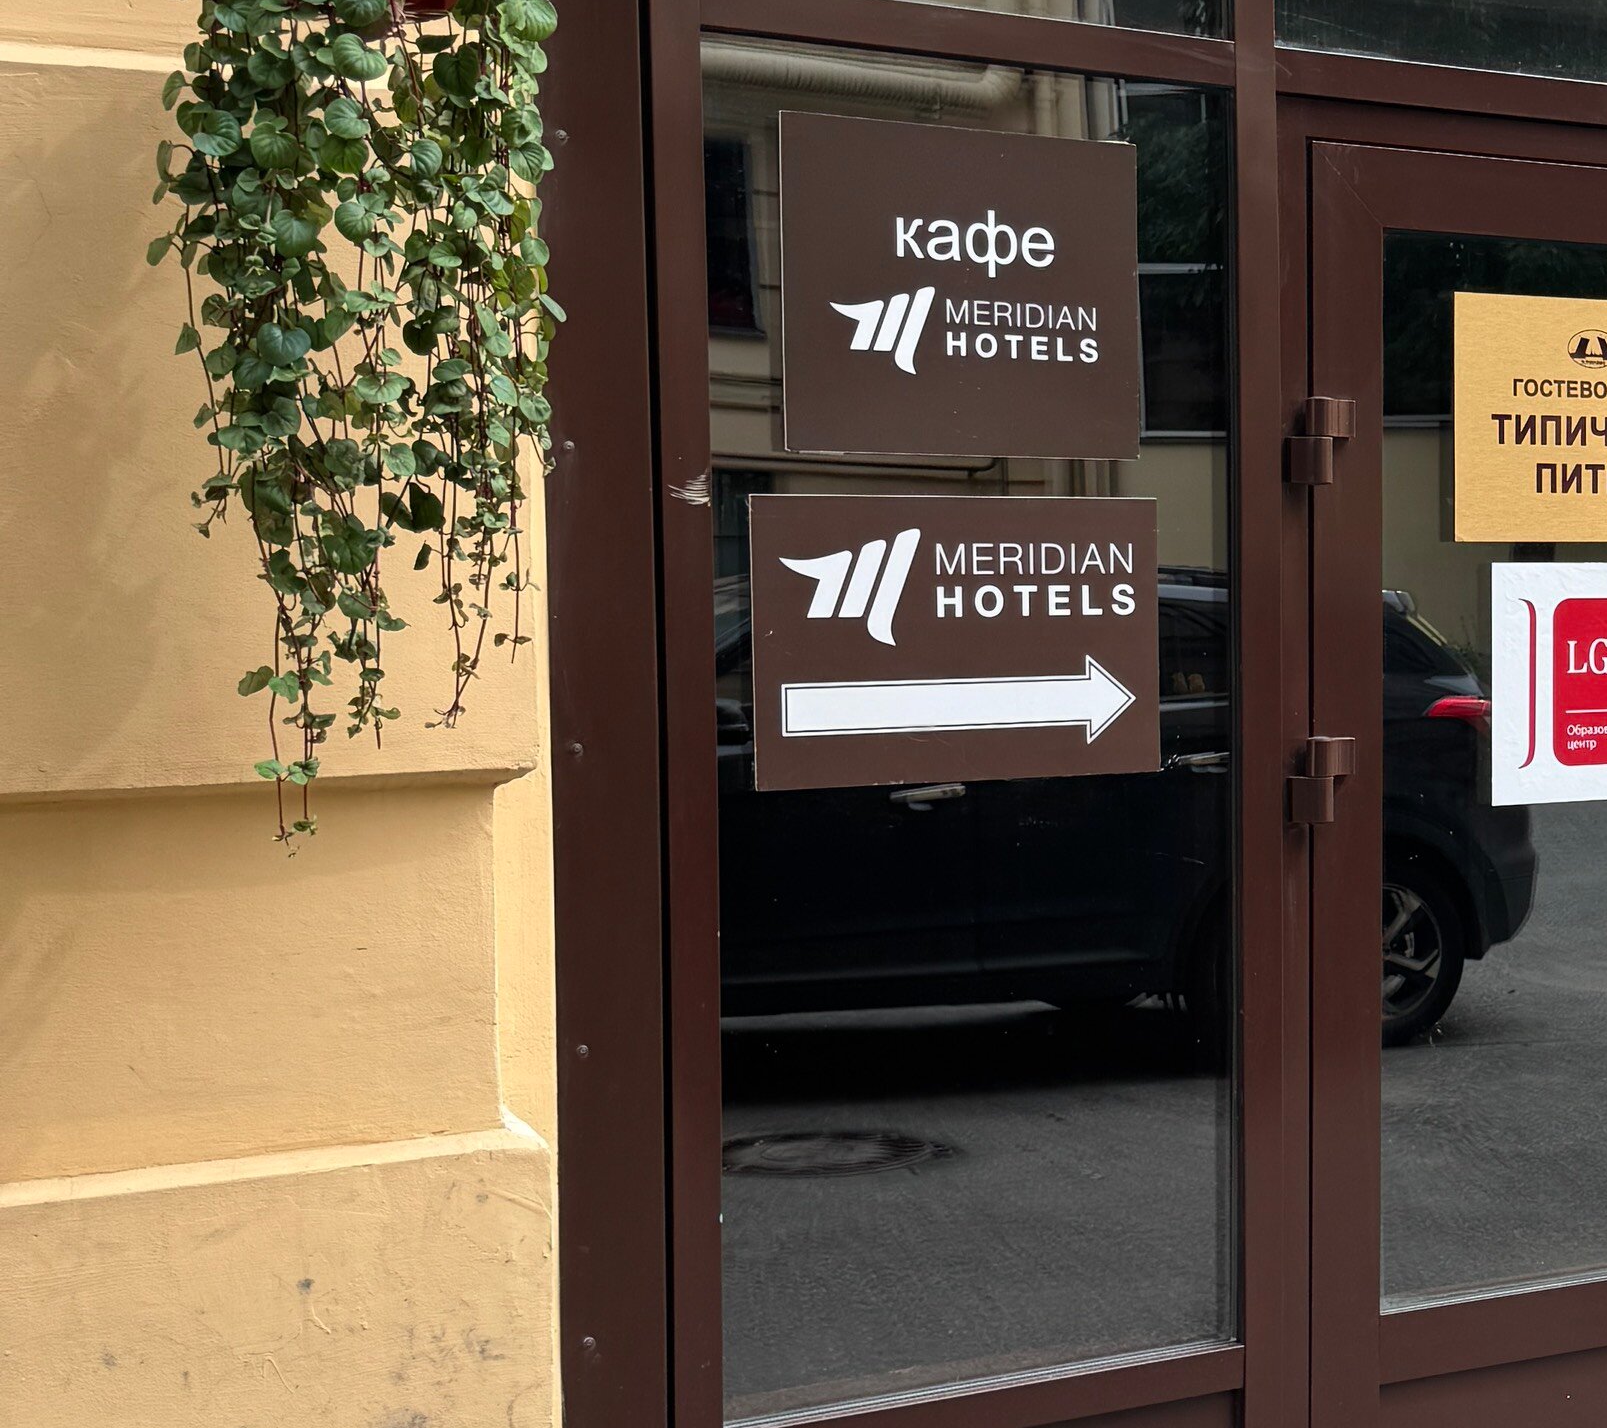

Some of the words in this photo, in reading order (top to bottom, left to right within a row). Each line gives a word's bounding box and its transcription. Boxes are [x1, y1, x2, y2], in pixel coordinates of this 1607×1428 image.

[896, 210, 1055, 277] кафе
[946, 298, 1097, 332] MERIDIAN
[947, 332, 1099, 363] HOTELS
[935, 542, 1133, 575] MERIDIAN
[936, 583, 1136, 618] HOTELS
[1567, 739, 1597, 751] центр
